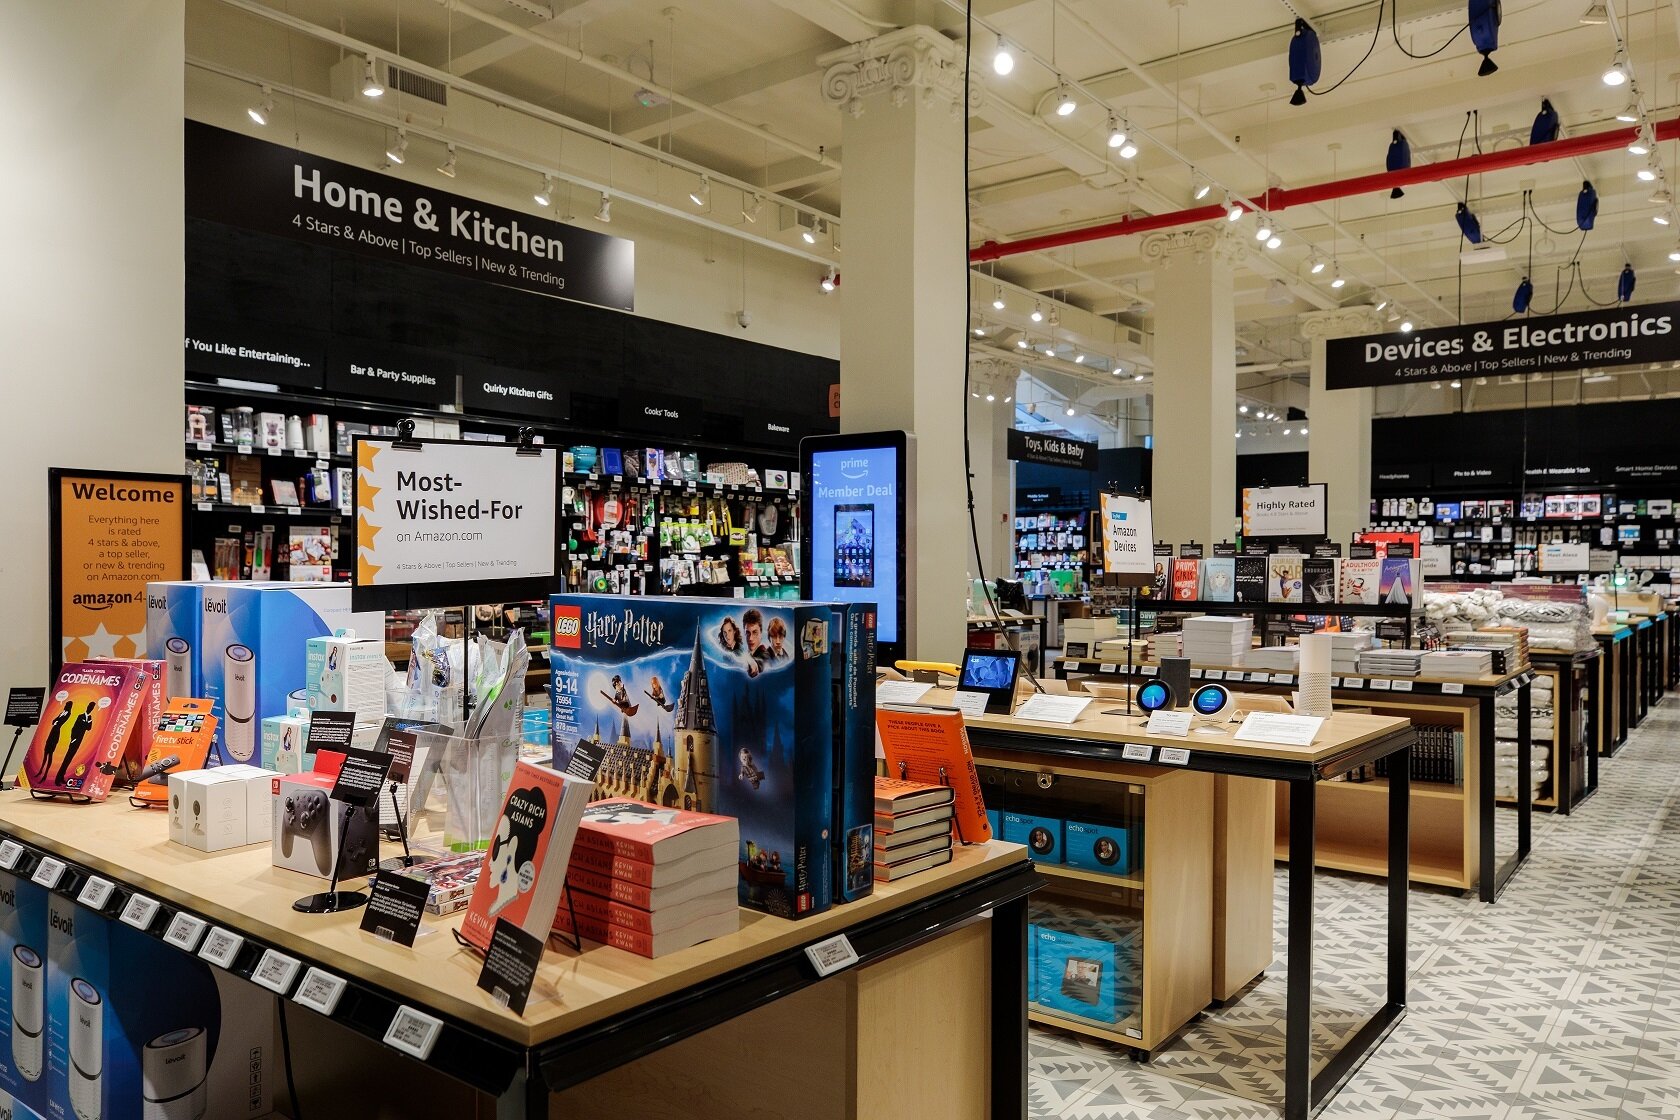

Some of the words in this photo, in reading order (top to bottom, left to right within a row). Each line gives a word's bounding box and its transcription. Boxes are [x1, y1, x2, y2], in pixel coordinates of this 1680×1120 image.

[294, 164, 402, 223] Home
[413, 198, 439, 232] &
[450, 206, 565, 262] Kitchen
[292, 213, 302, 228] 4
[306, 216, 340, 237] Stars
[344, 225, 354, 240] &
[358, 229, 398, 250] Above
[409, 240, 432, 258] Top
[435, 246, 472, 267] Sellers
[482, 258, 506, 276] New
[508, 264, 518, 277] &
[520, 266, 565, 290] Trending
[1365, 337, 1464, 363] Devices
[1472, 331, 1494, 353] &
[1504, 314, 1672, 350] Electronics
[184, 338, 190, 348] f
[192, 340, 212, 353] You
[215, 343, 236, 356] Like
[238, 346, 311, 368] Entertaining...
[1394, 368, 1402, 377] 4
[1404, 366, 1428, 376] Stars
[1430, 364, 1438, 374] &
[1440, 362, 1472, 374] Above
[1480, 359, 1498, 370] Top
[1502, 357, 1536, 368] Sellers
[1544, 354, 1568, 364] New
[1570, 352, 1580, 362] &
[1583, 348, 1632, 362] Trending
[350, 364, 366, 376] Bar
[368, 366, 375, 376] &
[377, 368, 400, 382] Party
[402, 372, 436, 386] Supplies
[484, 382, 508, 397] Quirky
[508, 386, 536, 399] Kitchen
[536, 388, 553, 400] Gifts
[644, 406, 663, 417] Cooks'
[664, 408, 678, 418] Tools
[768, 422, 790, 433] Bakeware
[1024, 436, 1042, 452] Toys,
[1044, 440, 1059, 454] Kids
[1060, 442, 1066, 454] &
[1068, 444, 1084, 460] Baby
[840, 458, 868, 470] prime
[397, 470, 462, 492] Most-
[72, 482, 174, 502] Welcome
[818, 486, 864, 498] Member
[867, 483, 892, 496] Deal
[396, 499, 522, 520] Wished-For
[1256, 500, 1286, 511] Highly
[1288, 500, 1314, 508] Rated
[88, 515, 138, 526] Everything
[396, 532, 411, 542] on
[415, 531, 483, 542] Amazon.com
[1113, 524, 1137, 537] Amazon
[88, 538, 94, 547] 4
[131, 539, 160, 548] above,
[1114, 540, 1137, 552] Devices
[107, 551, 122, 559] top
[125, 550, 150, 559] seller,
[128, 562, 165, 571] trending
[102, 572, 162, 581] Amazon.com.
[73, 593, 132, 604] amazon
[556, 616, 580, 636] LEGO
[585, 610, 623, 648] Harry
[624, 608, 664, 646] Potter
[61, 673, 121, 687] CODENAMES
[556, 677, 578, 694] 9-14
[556, 696, 572, 705] 75954
[108, 691, 139, 759] CODENAMES
[556, 722, 566, 730] 878
[510, 795, 529, 810] CRAZY
[528, 803, 546, 819] RICH
[511, 811, 534, 829] ASIANS
[1069, 824, 1084, 832] echo
[616, 841, 635, 851] KEVIN
[618, 849, 636, 858] KWAN
[615, 861, 633, 870] KEVIN
[615, 869, 632, 879] KWAN
[615, 884, 632, 893] KEVIN
[615, 892, 632, 901] KWAN
[469, 912, 489, 929] KEVIN
[615, 910, 633, 920] KEVIN
[616, 918, 634, 927] KWAN
[616, 930, 633, 940] KEVIN
[1041, 933, 1056, 942] echo
[616, 939, 633, 949] KWAN
[165, 1053, 186, 1065] levoit
